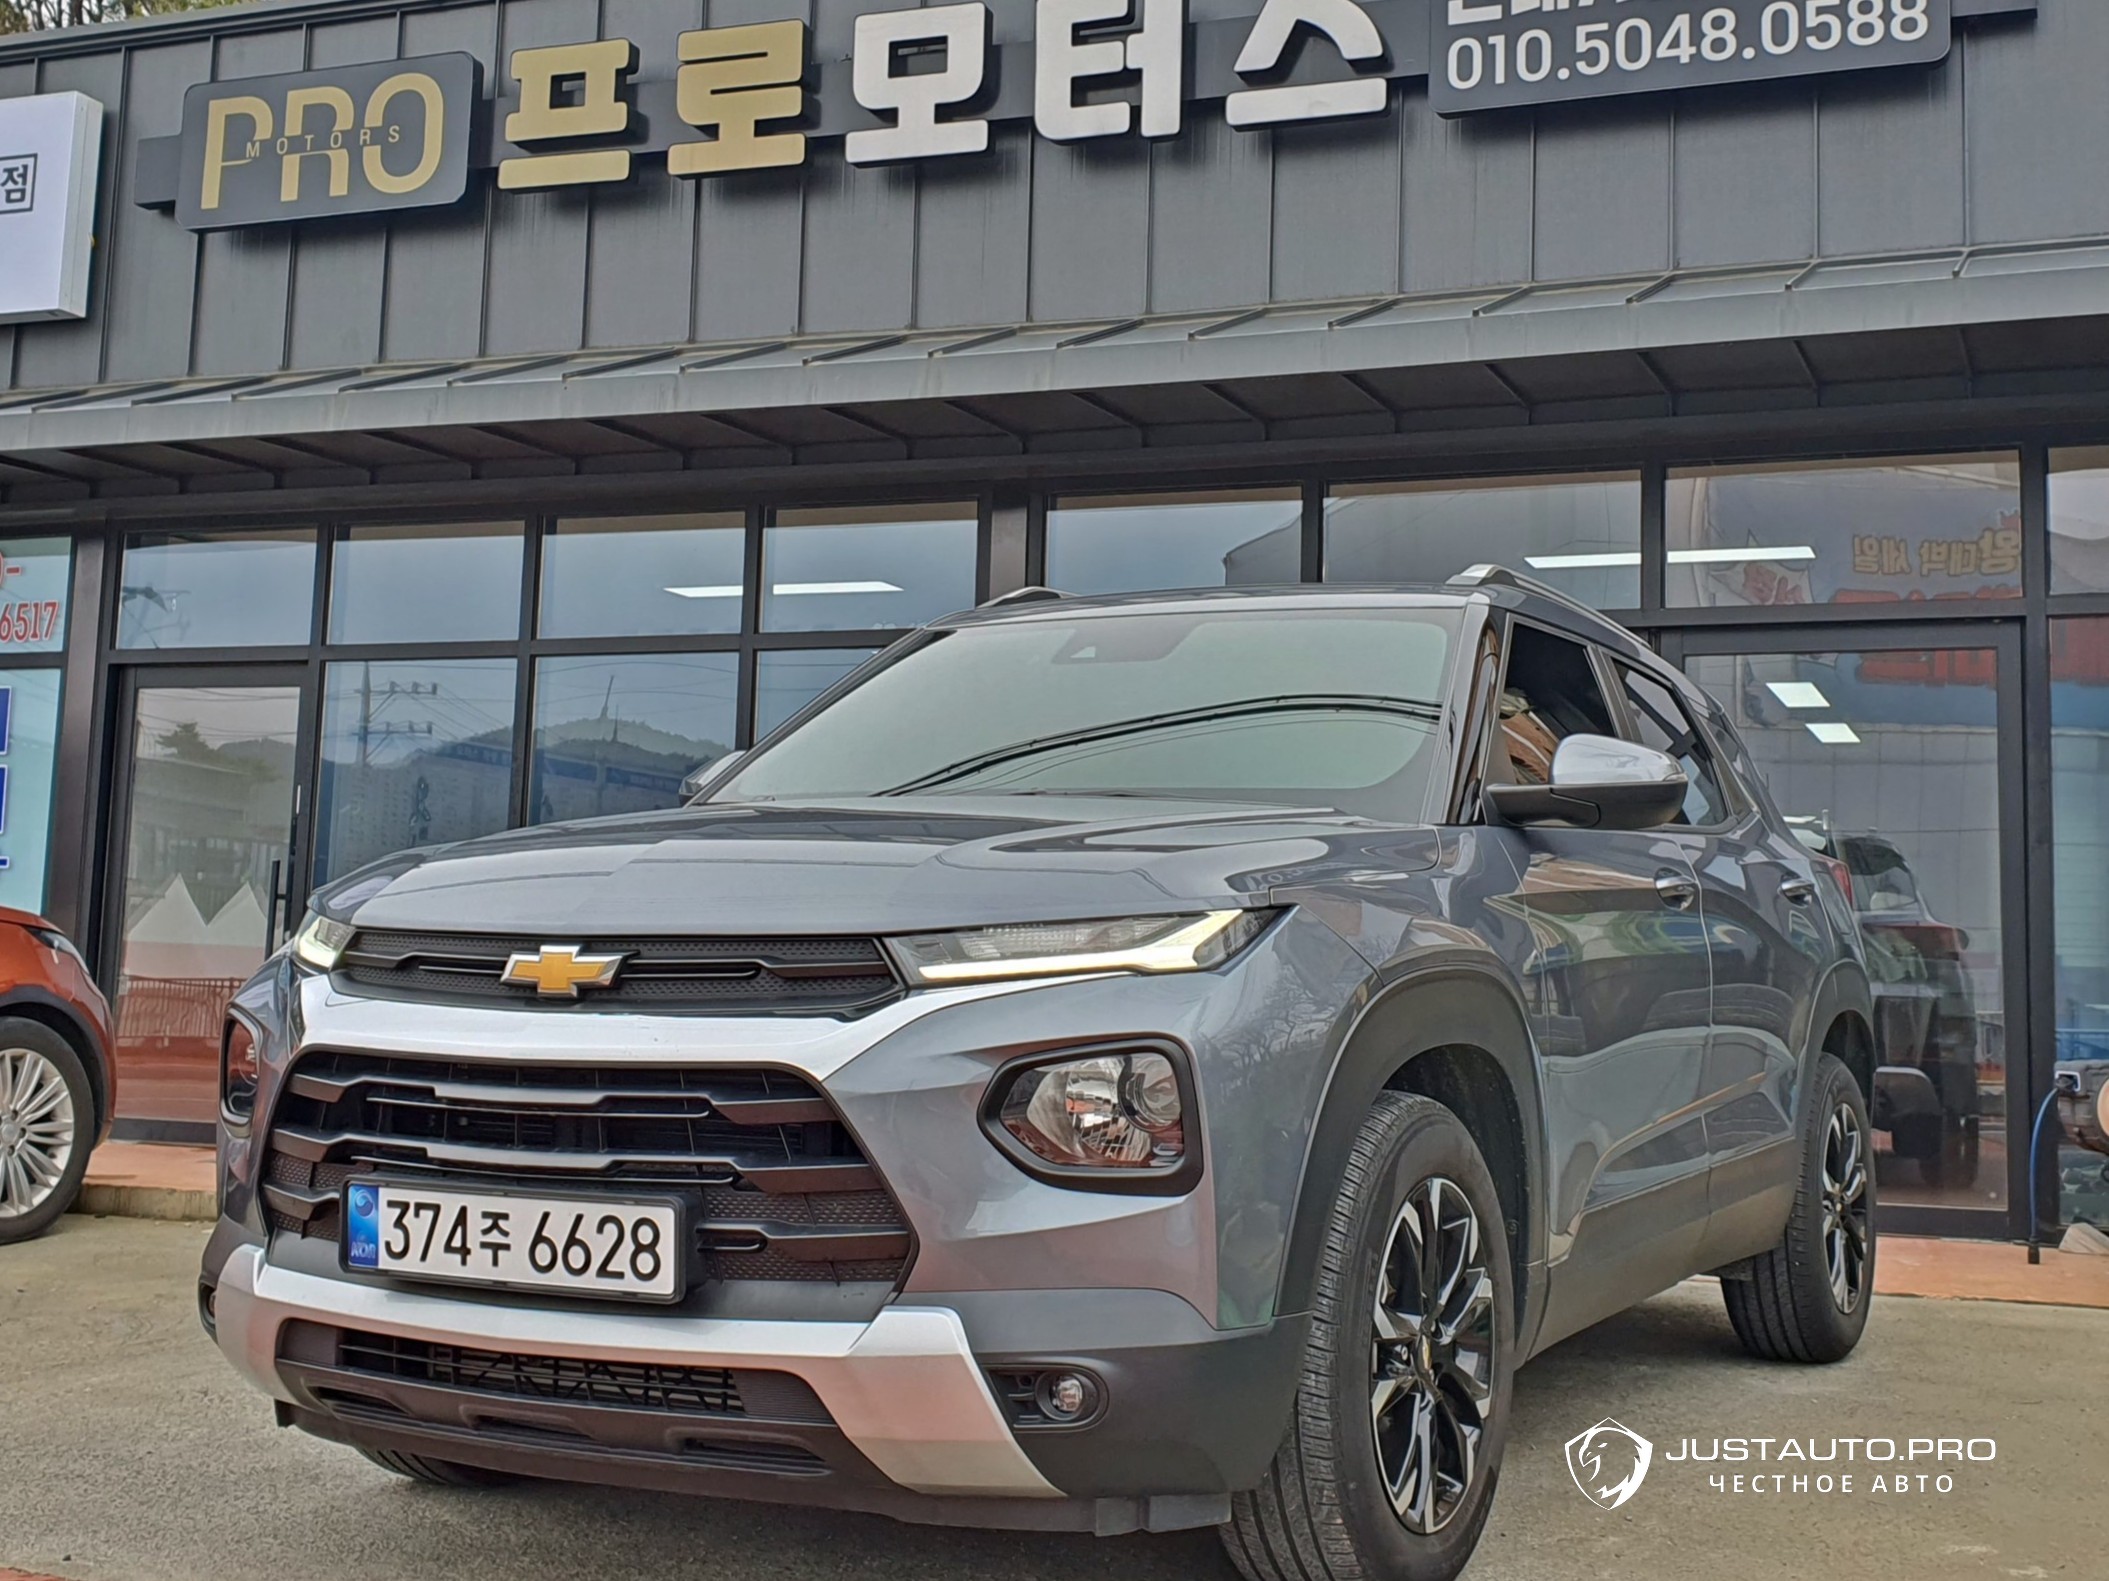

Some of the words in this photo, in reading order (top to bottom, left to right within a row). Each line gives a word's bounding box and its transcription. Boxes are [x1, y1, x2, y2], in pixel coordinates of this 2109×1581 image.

[1447, 0, 1929, 90] 010.5048.0588
[201, 72, 444, 210] PRO
[245, 124, 402, 158] MOTORS
[0, 600, 59, 643] 6517
[384, 1199, 512, 1268] 374주
[528, 1211, 661, 1282] 6628
